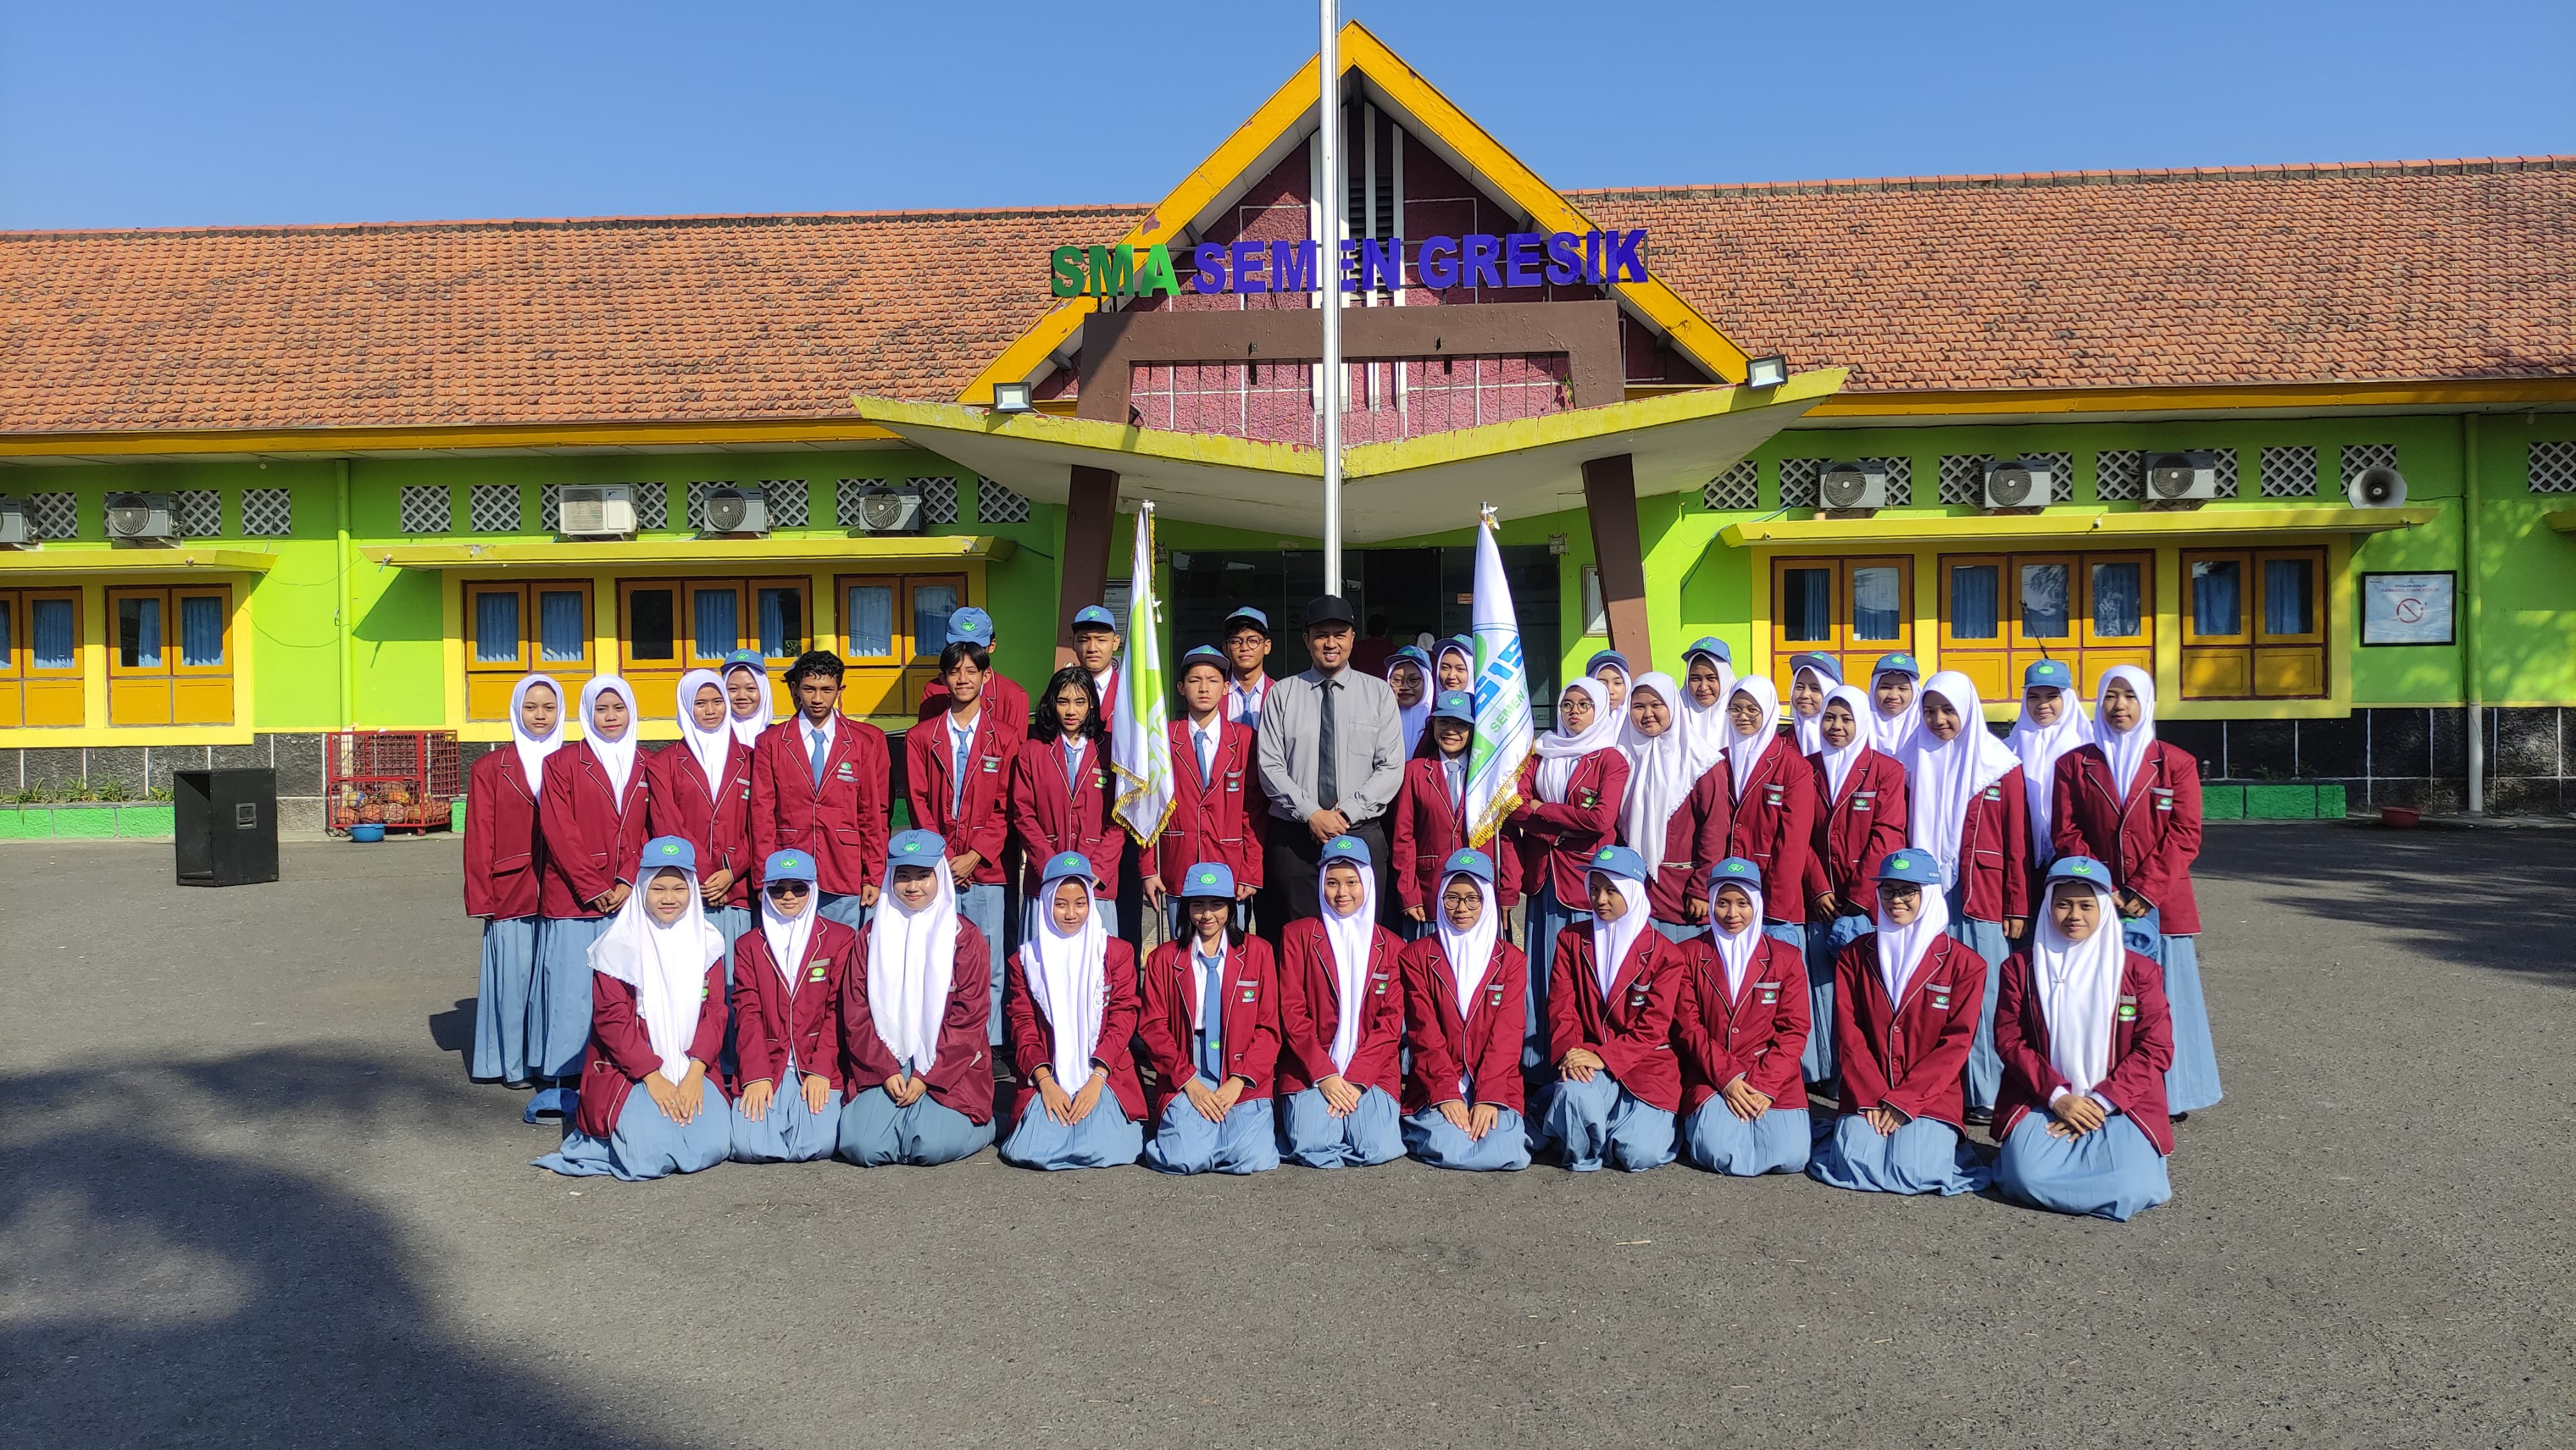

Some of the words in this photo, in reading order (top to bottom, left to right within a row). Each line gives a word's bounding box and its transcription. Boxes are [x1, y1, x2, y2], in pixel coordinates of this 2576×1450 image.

[1051, 243, 1181, 297] SMA
[1417, 230, 1648, 289] GRESIK
[1490, 690, 1525, 733] SEMEN
